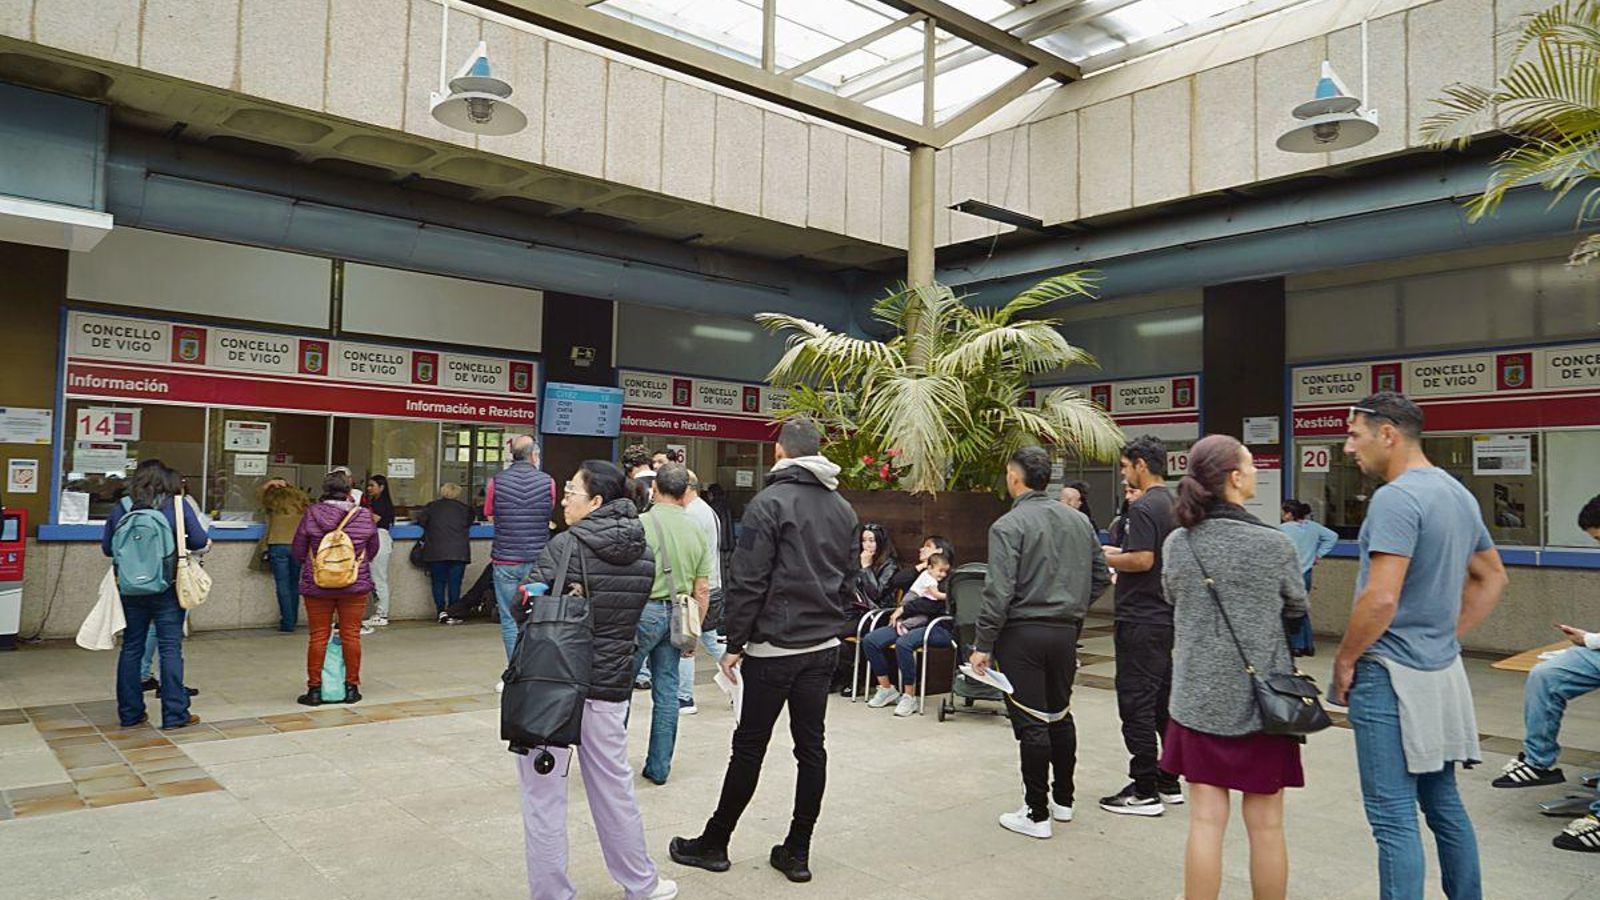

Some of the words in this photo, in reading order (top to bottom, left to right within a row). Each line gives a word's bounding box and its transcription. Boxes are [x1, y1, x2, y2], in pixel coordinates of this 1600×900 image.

[83, 323, 161, 341] CONCELLO
[91, 337, 111, 349] DE
[116, 339, 152, 352] VIGO
[220, 338, 289, 354] CONCELLO
[228, 351, 245, 361] DE
[250, 352, 281, 364] VIGO
[343, 350, 404, 365] CONCELLO
[1552, 354, 1600, 367] CONCE
[350, 363, 366, 373] DE
[369, 364, 397, 376] VIGO
[448, 361, 502, 375] CONCELLO
[1415, 363, 1486, 377] CONCELLO
[1562, 368, 1582, 379] DE
[1587, 367, 1600, 377] V
[69, 373, 169, 393] Información
[454, 372, 469, 382] DE
[471, 374, 497, 384] VIGO
[1302, 372, 1362, 385] CONCELLO
[1423, 377, 1442, 388] DE
[1445, 375, 1478, 386] VIGO
[624, 379, 668, 391] CONCELLO
[1120, 385, 1166, 397] CONCELLO
[1308, 385, 1325, 395] DE
[1327, 383, 1355, 394] VIGO
[629, 388, 641, 398] DE
[642, 390, 663, 400] VIGO
[699, 386, 738, 398] CONCELLO
[703, 395, 714, 405] DE
[715, 396, 734, 406] VIGO
[1124, 396, 1137, 406] DE
[1138, 394, 1160, 405] VIGO
[406, 399, 477, 416] Información
[478, 407, 486, 415] e
[488, 407, 535, 419] Rexistro
[80, 415, 112, 436] 14
[621, 416, 672, 429] nformación
[673, 420, 680, 429] e
[681, 420, 717, 432] Rexistro
[1295, 416, 1343, 429] Xestión
[506, 438, 513, 454] 1
[1168, 455, 1189, 471] 19
[1303, 450, 1328, 468] 20
